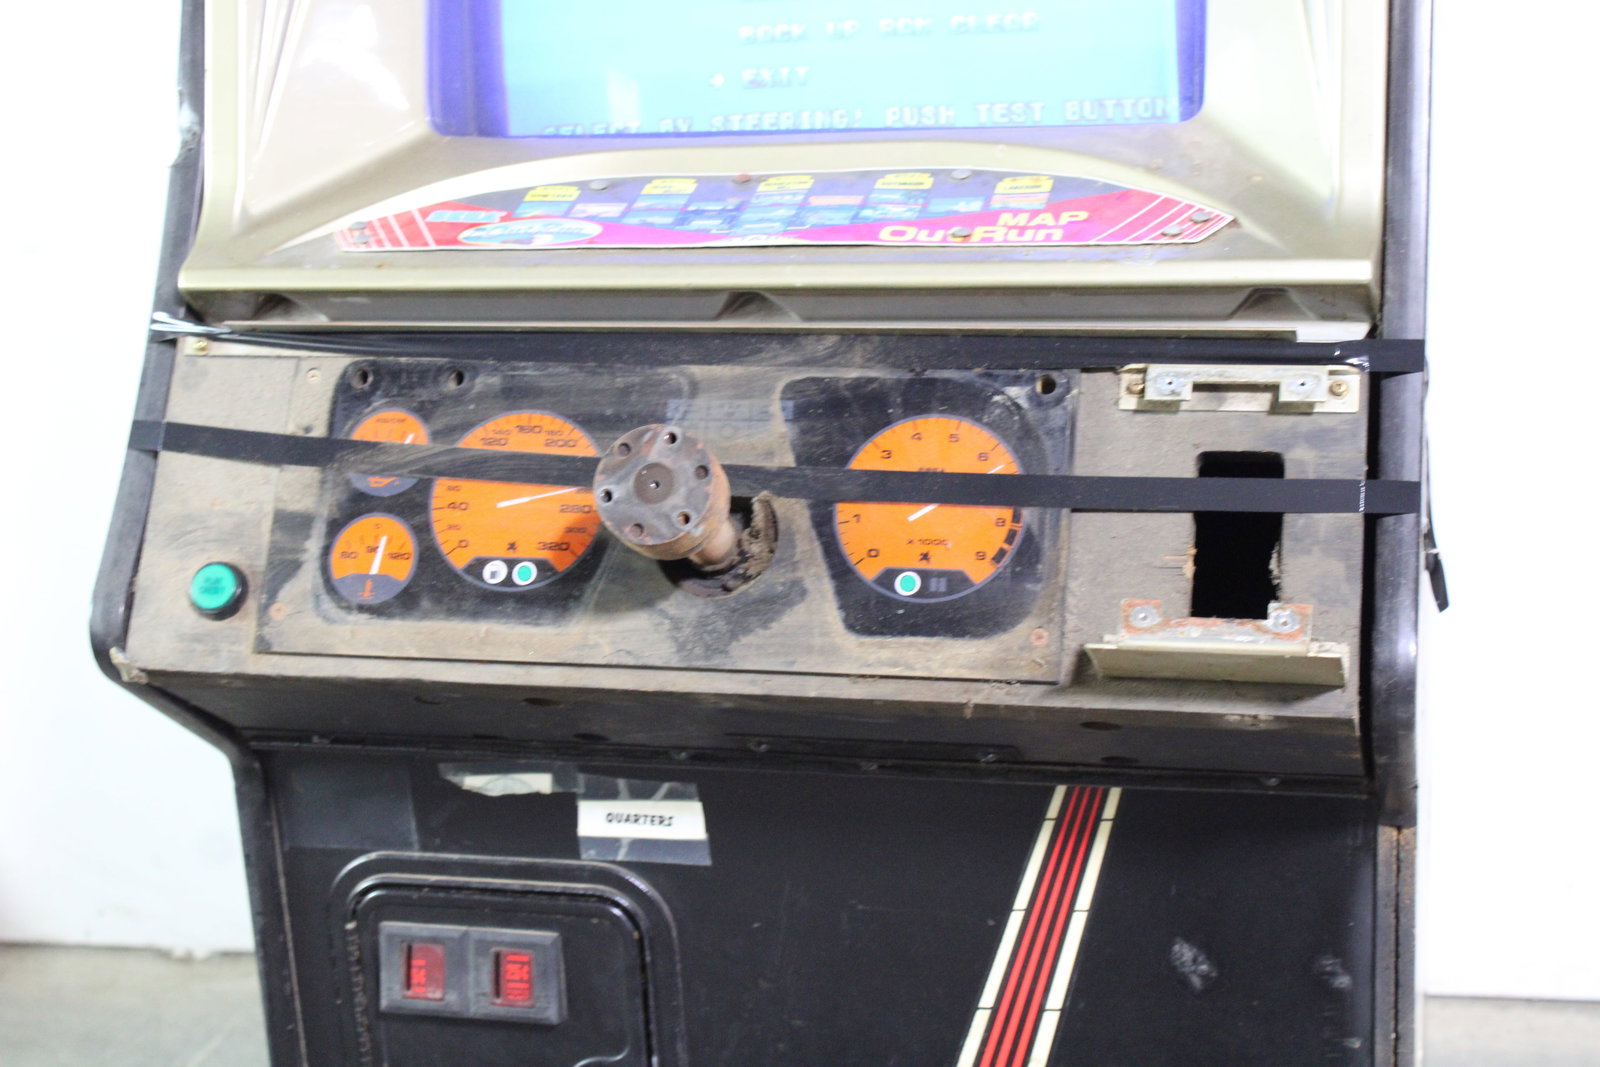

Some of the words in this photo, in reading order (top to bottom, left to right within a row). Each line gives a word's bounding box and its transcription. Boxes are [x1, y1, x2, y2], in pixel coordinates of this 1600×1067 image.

[741, 65, 811, 89] EXIT
[711, 108, 863, 132] STEERING!
[885, 104, 956, 126] PUSH
[975, 101, 1045, 124] TEST
[1064, 97, 1170, 122] BUTTON
[997, 210, 1089, 228] MAP
[911, 432, 922, 441] 4
[949, 433, 960, 443] 5
[544, 438, 577, 448] 200
[881, 449, 892, 459] 3
[978, 451, 989, 461] 6
[446, 501, 469, 511] 40
[538, 540, 569, 551] 320
[867, 547, 879, 558] 0
[975, 551, 986, 561] 9
[605, 811, 674, 828] QUARTERS
